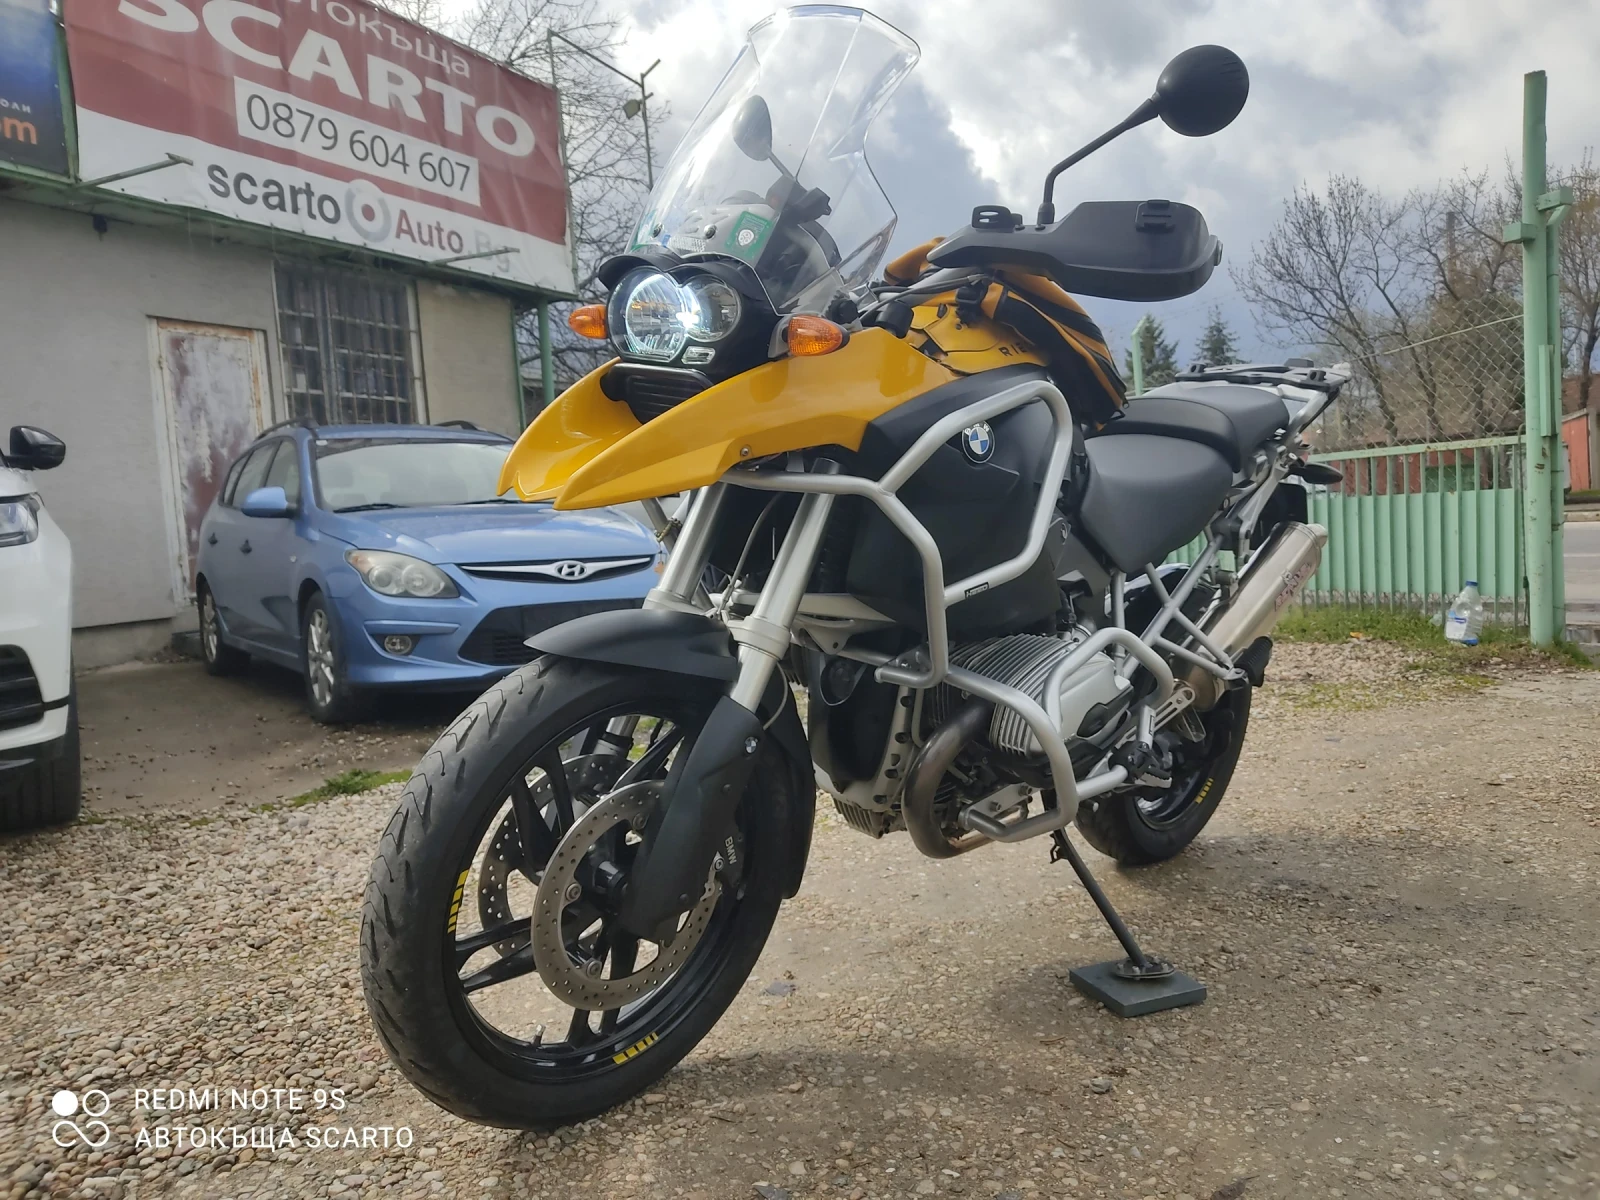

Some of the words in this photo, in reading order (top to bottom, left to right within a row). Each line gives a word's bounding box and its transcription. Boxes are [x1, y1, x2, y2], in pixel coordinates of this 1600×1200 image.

[246, 93, 339, 151] 0879
[349, 129, 410, 175] 604
[419, 152, 470, 192] 607
[206, 163, 342, 225] scarto
[724, 835, 737, 865] BMW
